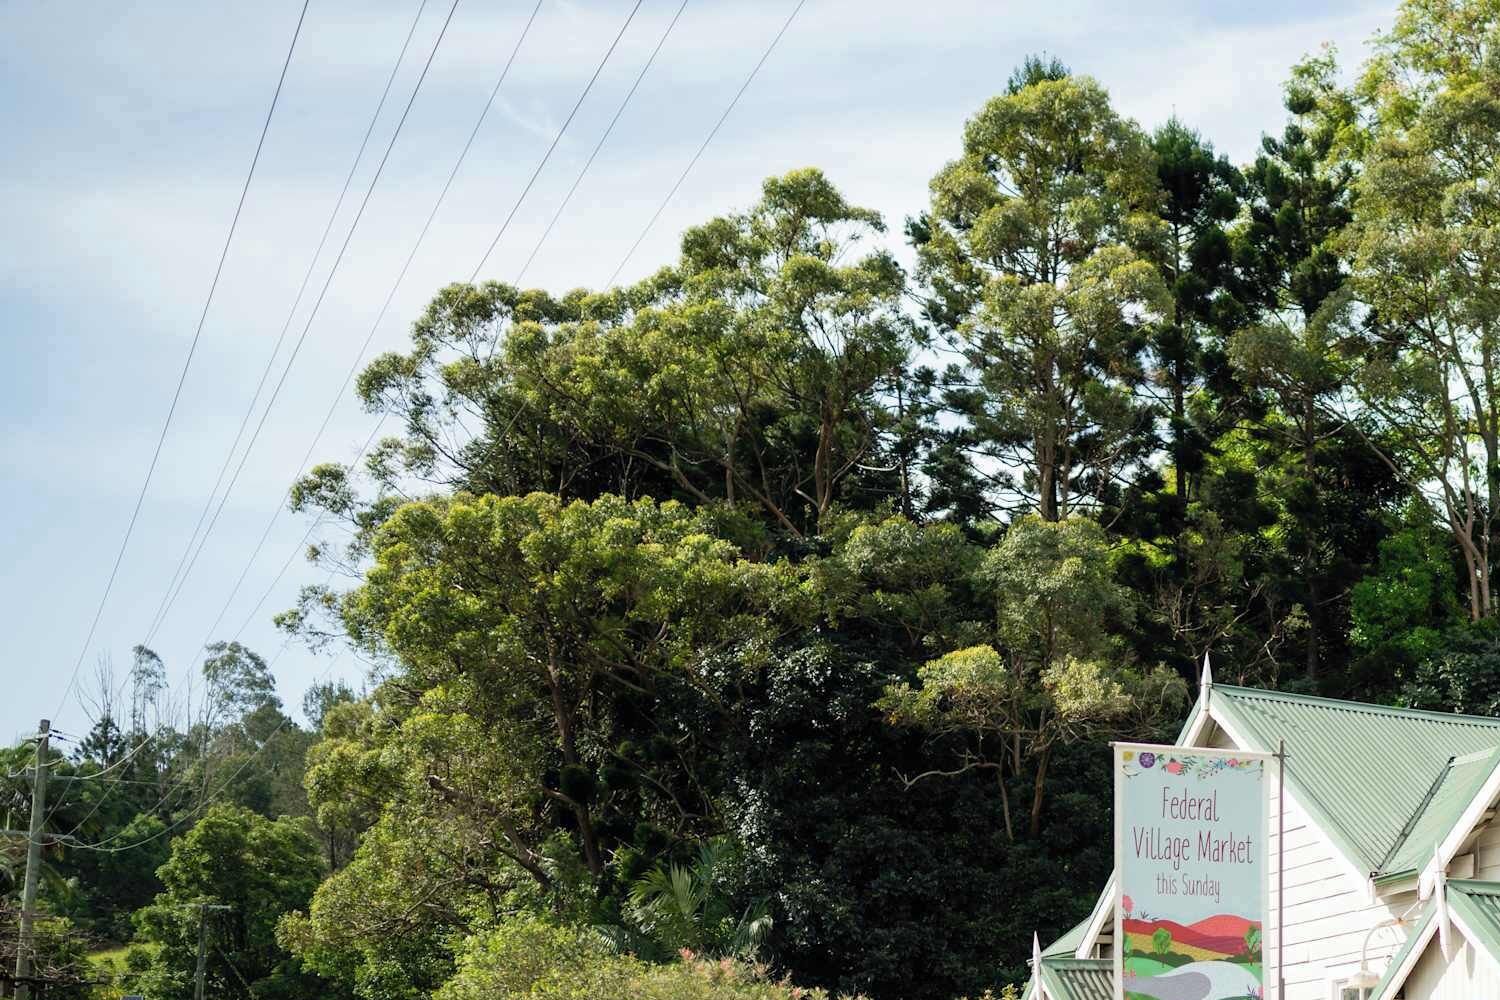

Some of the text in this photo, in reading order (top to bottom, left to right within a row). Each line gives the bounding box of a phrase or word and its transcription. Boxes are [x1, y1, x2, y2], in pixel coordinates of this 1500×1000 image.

[1162, 786, 1220, 822] Federal
[1133, 826, 1253, 871] Village Market
[1156, 872, 1220, 904] this Sunday
